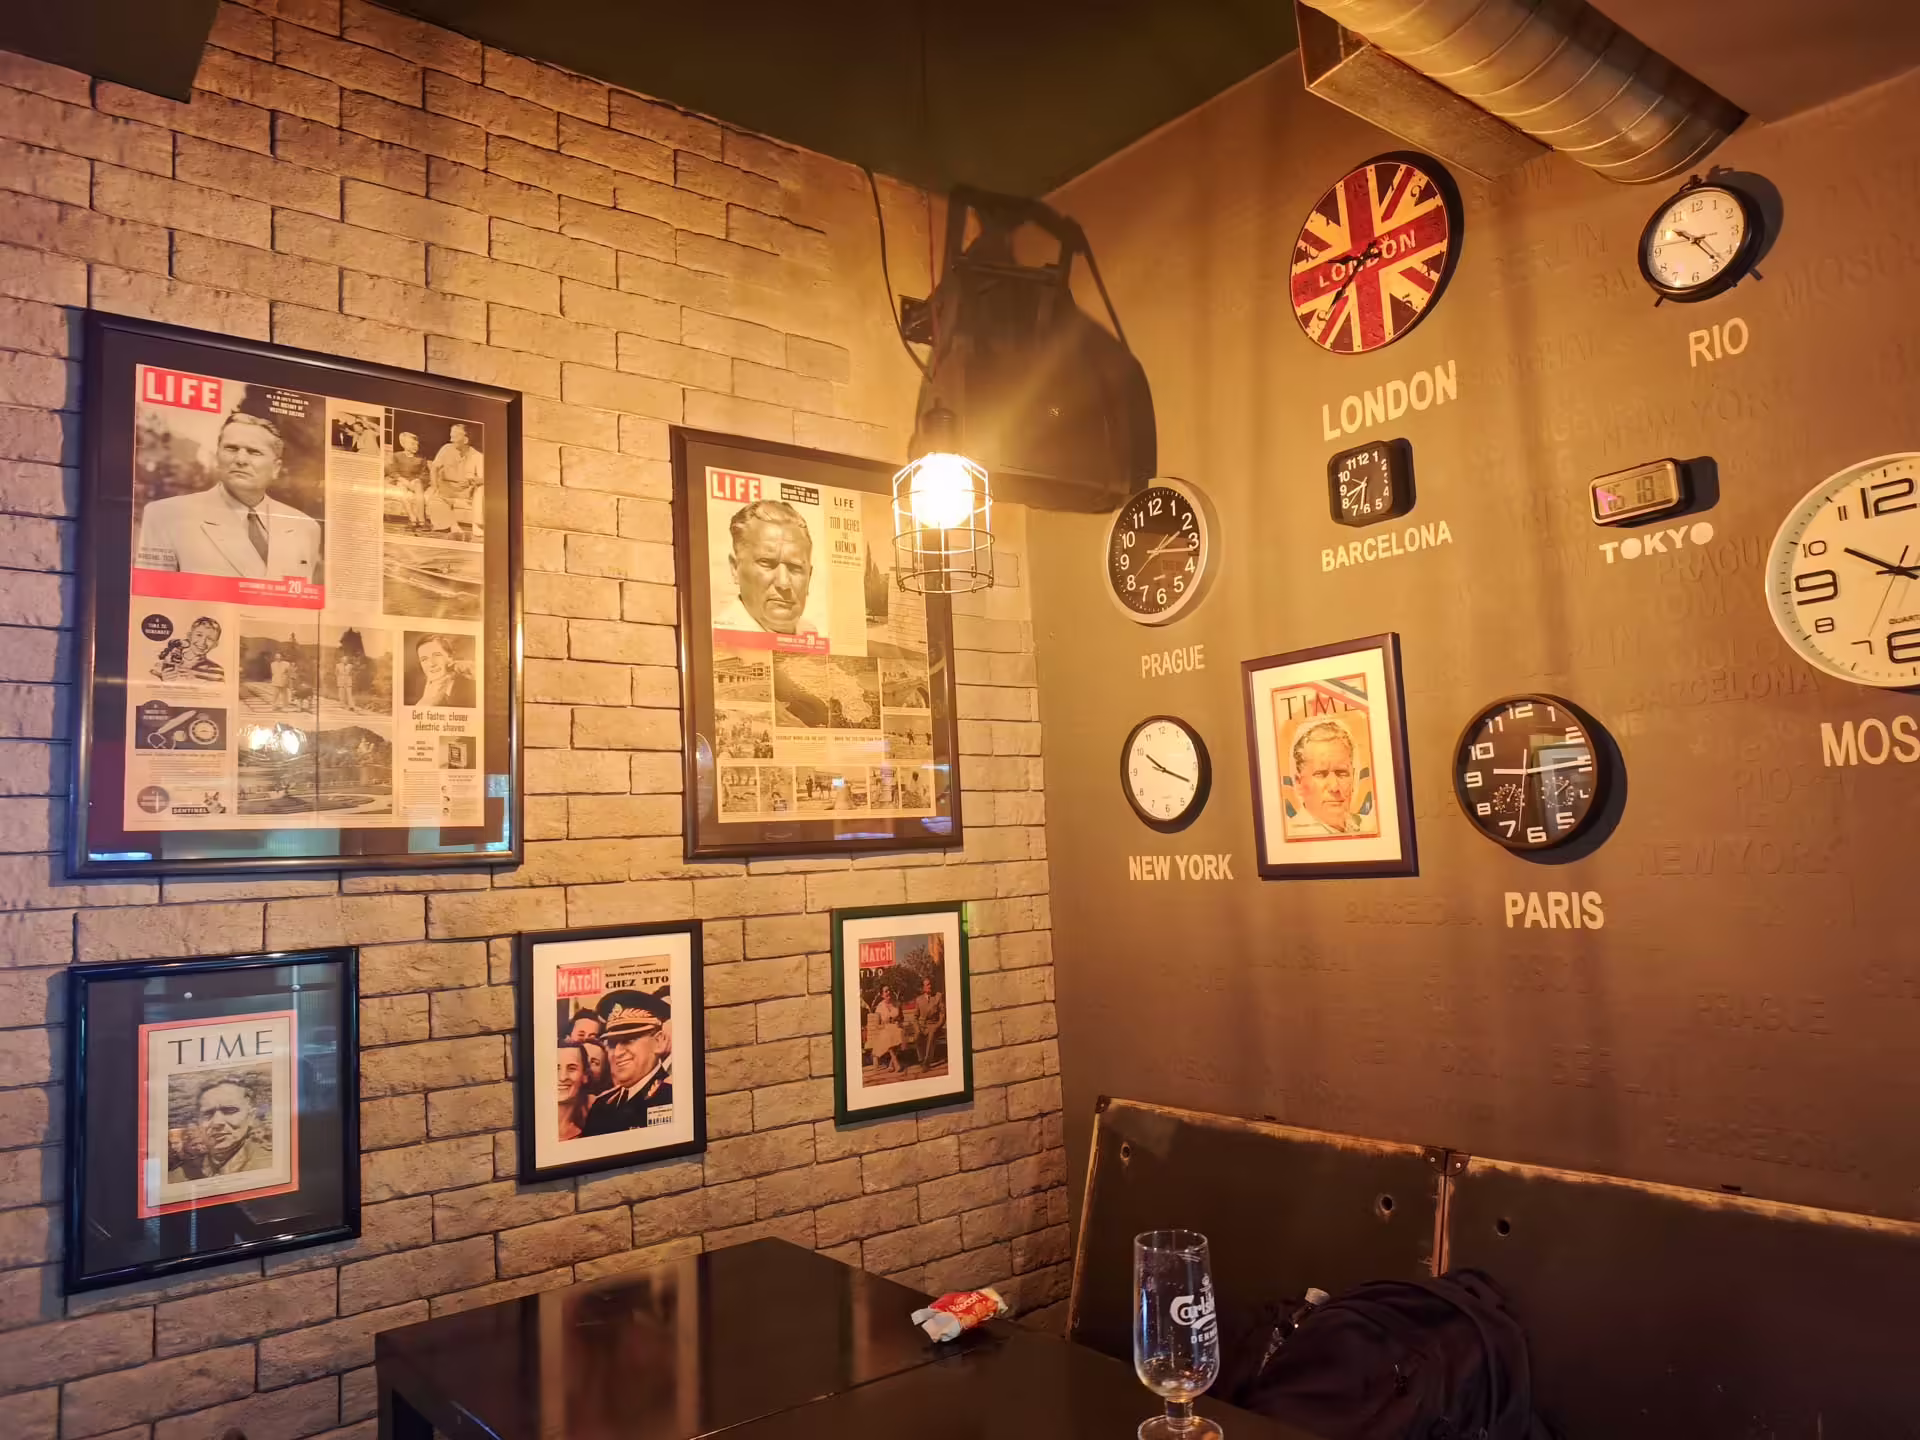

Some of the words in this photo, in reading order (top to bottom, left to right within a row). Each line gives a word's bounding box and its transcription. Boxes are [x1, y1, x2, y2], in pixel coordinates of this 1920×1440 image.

[1691, 199, 1703, 213] 12
[1712, 199, 1718, 210] 1
[1672, 211, 1683, 223] 11
[1725, 207, 1734, 219] 2
[1730, 224, 1740, 236] 3
[1654, 247, 1662, 258] 9
[1726, 244, 1733, 255] 4
[1659, 262, 1668, 274] 8
[1691, 271, 1700, 282] 6
[1689, 317, 1749, 368] RIO
[145, 371, 218, 409] LIFE
[1322, 360, 1457, 441] LONDON
[1346, 457, 1357, 470] 11
[1357, 452, 1369, 465] 12
[1372, 451, 1378, 462] 1
[1381, 458, 1387, 470] 2
[1338, 470, 1350, 483] 10
[711, 472, 761, 501] LIFE
[1340, 484, 1347, 496] 9
[834, 496, 854, 508] LIFE
[1342, 498, 1350, 509] 8
[1375, 498, 1383, 510] 5
[1861, 478, 1915, 519] 12
[1148, 498, 1162, 516] 12
[1170, 500, 1176, 516] 1
[1352, 504, 1358, 517] 7
[1363, 503, 1371, 514] 6
[1132, 511, 1145, 529] 11
[1181, 513, 1193, 530] 2
[1122, 531, 1136, 549] 10
[1188, 533, 1199, 549] 3
[1321, 520, 1454, 573] BARCELONA
[1599, 521, 1714, 564] TOKYO
[1803, 540, 1827, 558] 10
[1120, 554, 1130, 570] 9
[1185, 557, 1195, 573] 4
[287, 580, 301, 594] 20
[1127, 575, 1136, 591] 8
[1173, 576, 1184, 592] 5
[1795, 569, 1838, 606] 9
[1140, 585, 1149, 602] 7
[1156, 588, 1167, 604] 6
[1815, 617, 1834, 633] 8
[1852, 639, 1873, 655] 7
[1887, 627, 1920, 664] 6
[1141, 644, 1205, 678] PRAGUE
[1508, 704, 1533, 719] 12
[1547, 706, 1556, 722] 1
[1486, 716, 1504, 733] 11
[1565, 726, 1586, 744] 2
[1820, 715, 1920, 768] MOS
[1471, 742, 1494, 760] 10
[1465, 771, 1483, 788] 9
[1477, 802, 1491, 816] 8
[1556, 811, 1576, 830] 5
[1499, 821, 1516, 838] 7
[1527, 826, 1547, 843] 6
[1128, 855, 1171, 881] NEW
[1175, 853, 1234, 880] YORK
[1504, 891, 1605, 930] PARIS
[861, 942, 893, 962] MATCH
[557, 967, 600, 993] MATCH
[860, 968, 883, 978] TITO
[605, 979, 637, 989] CHEZ
[642, 976, 669, 985] TITO
[168, 1029, 273, 1065] TIME
